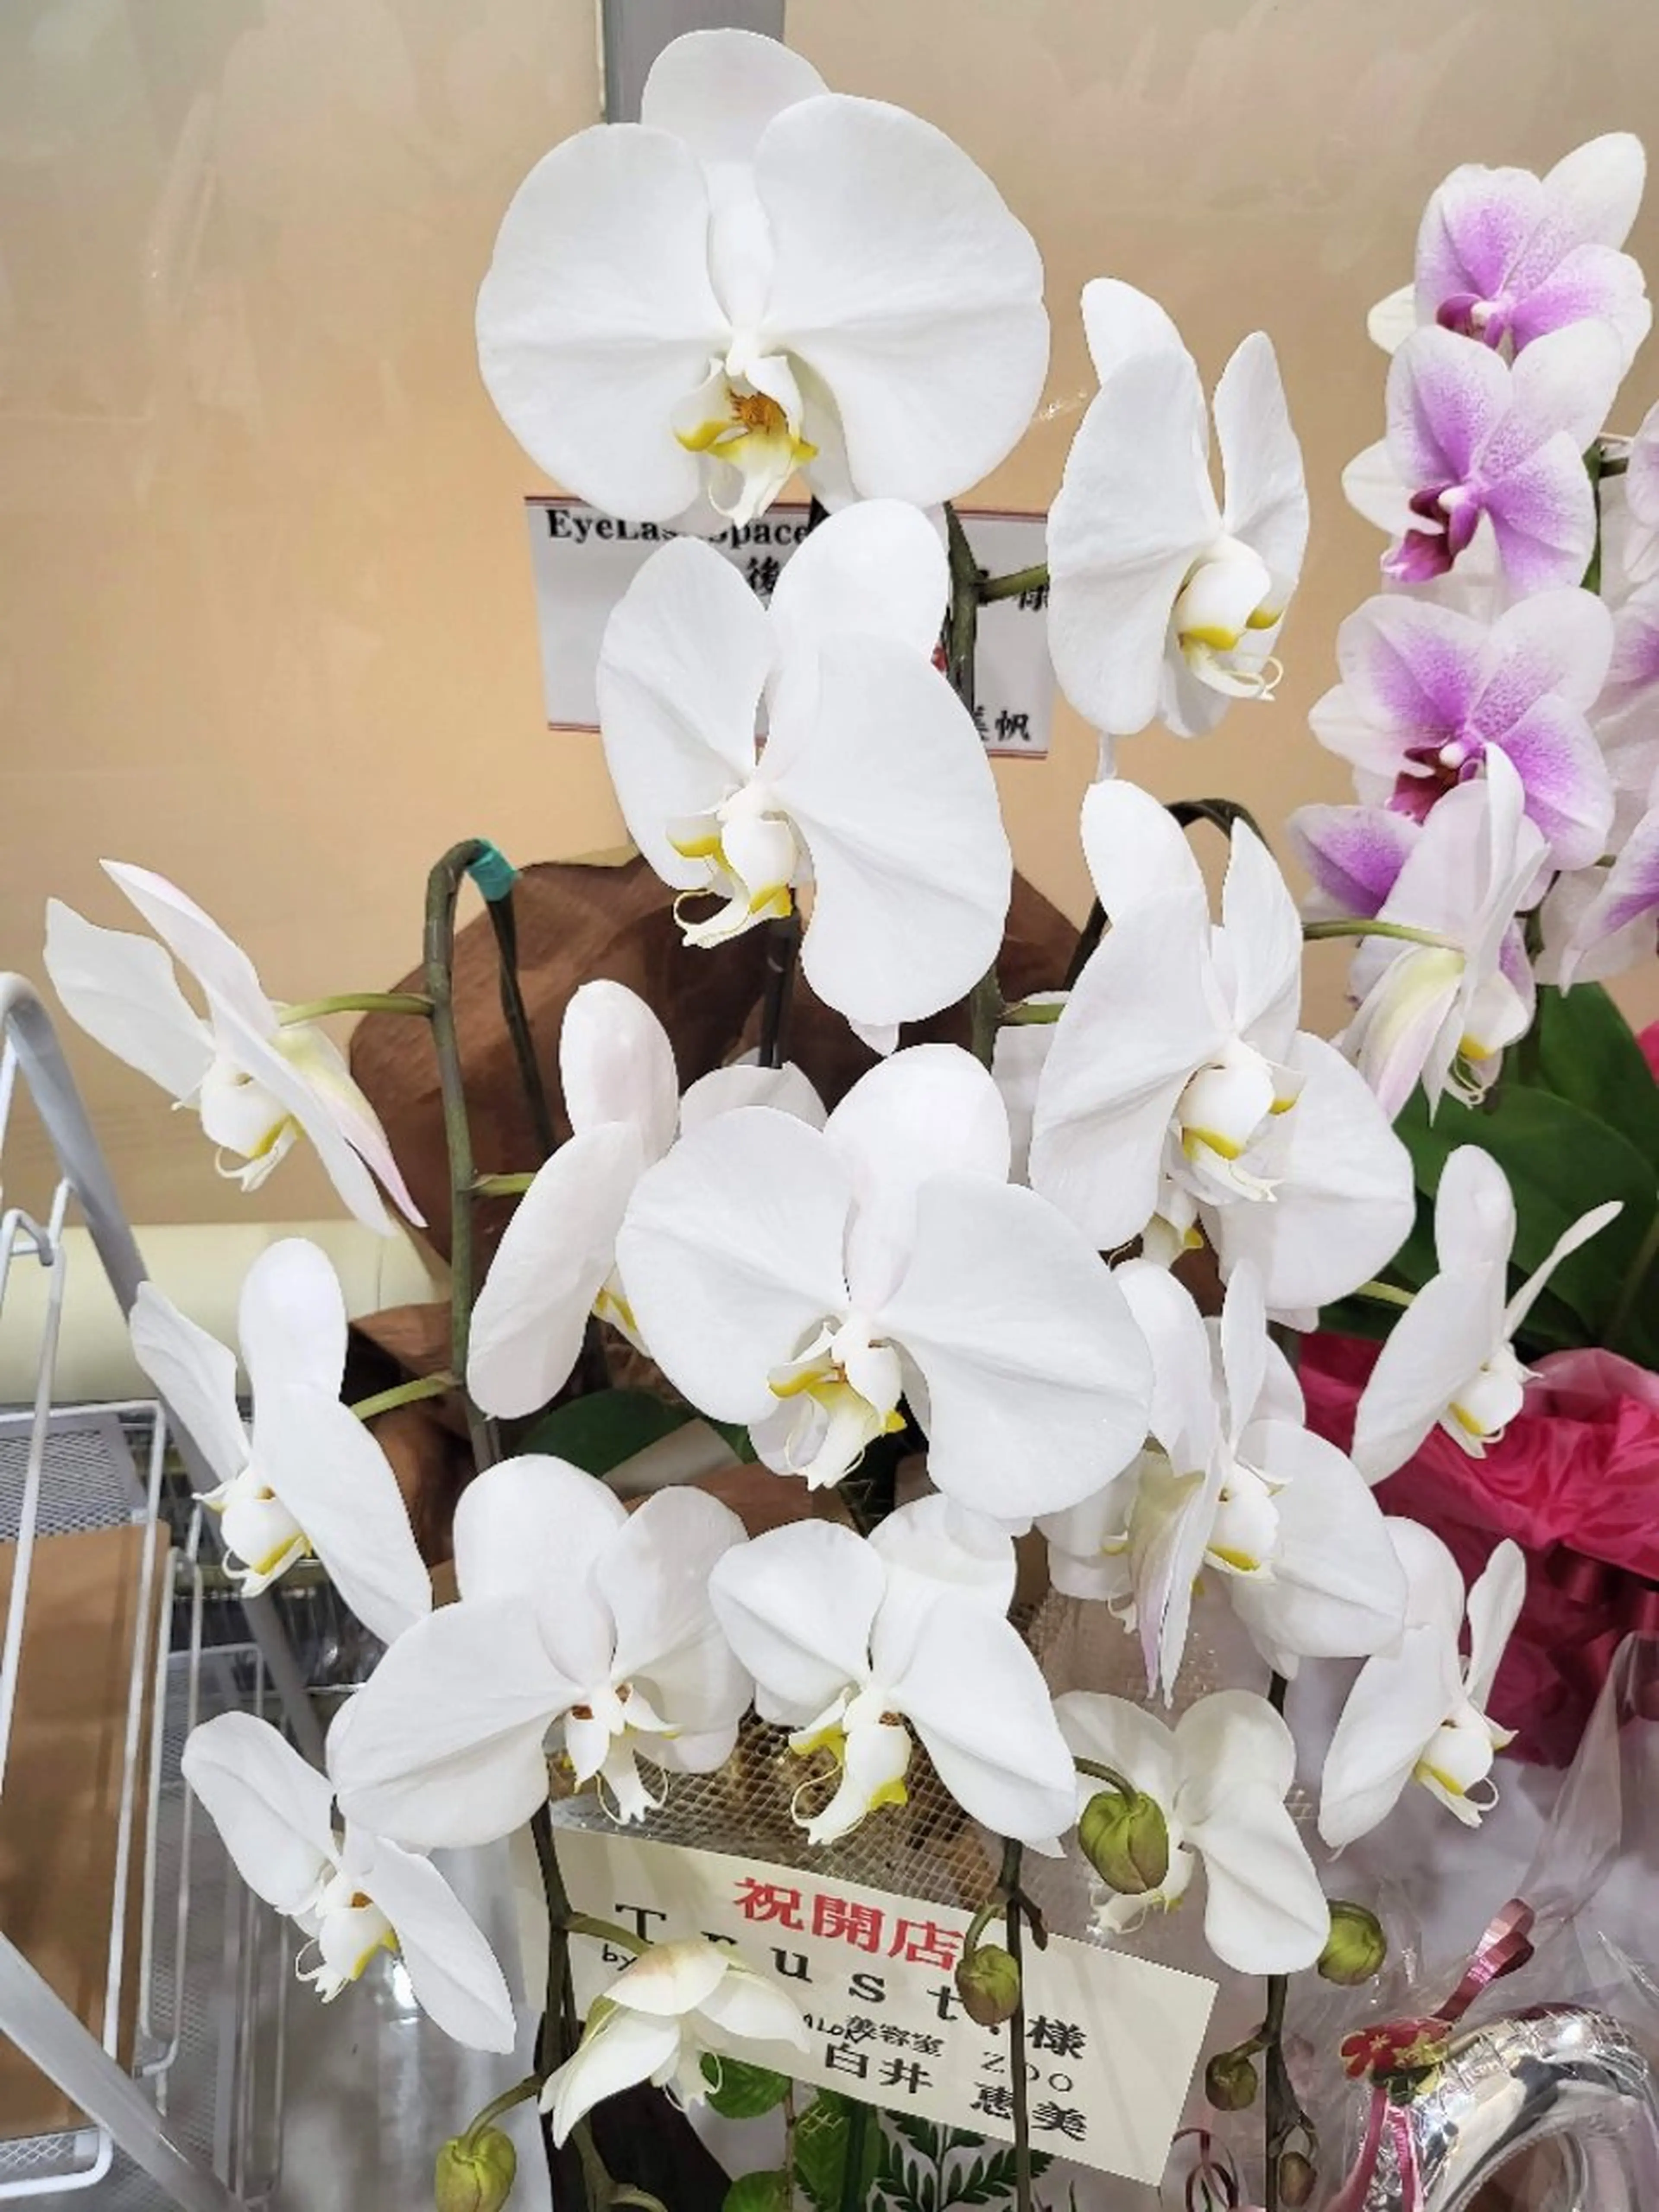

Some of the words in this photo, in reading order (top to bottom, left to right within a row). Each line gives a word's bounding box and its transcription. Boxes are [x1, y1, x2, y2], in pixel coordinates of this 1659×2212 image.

[734, 1877, 966, 1971] 祝開店
[1026, 2015, 1087, 2059] 様
[825, 2043, 933, 2093] 白井
